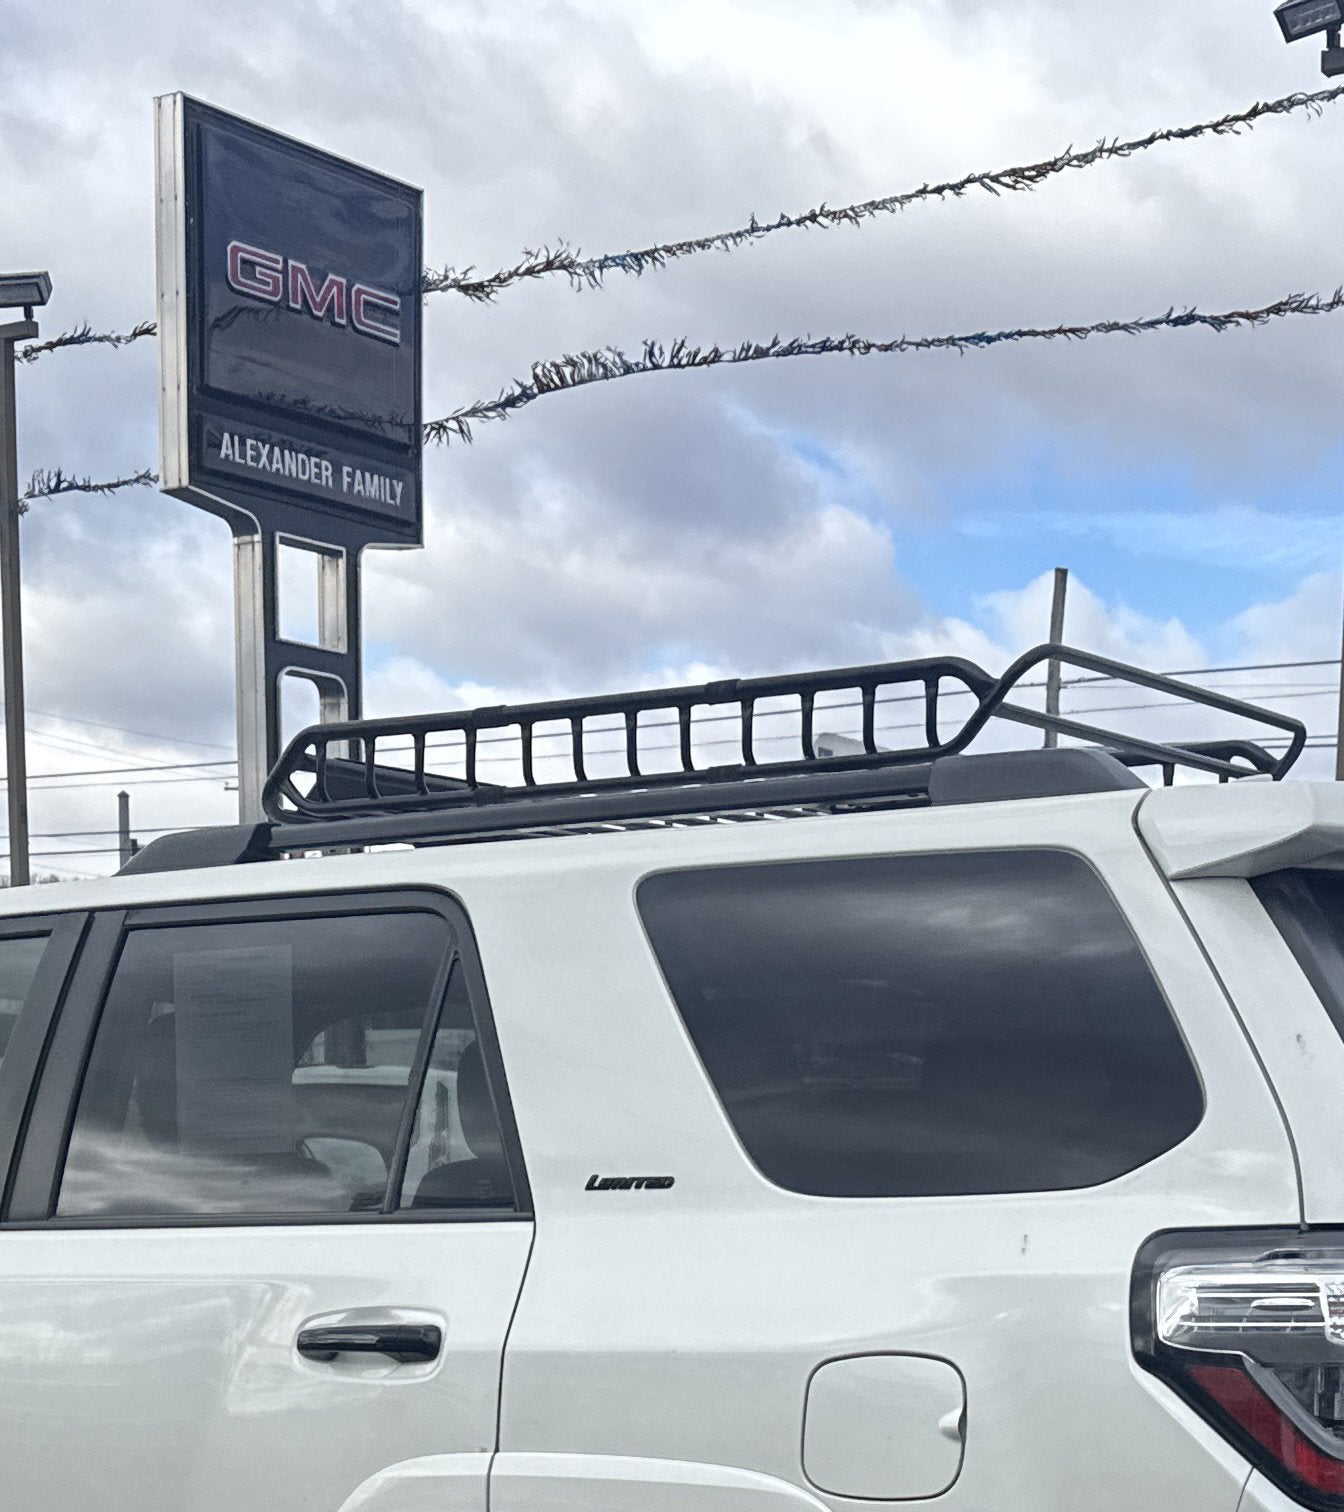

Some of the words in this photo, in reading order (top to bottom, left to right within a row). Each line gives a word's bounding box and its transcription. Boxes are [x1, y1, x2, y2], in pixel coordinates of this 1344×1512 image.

[227, 240, 401, 344] GMC
[219, 432, 333, 490] ALEXANDER
[342, 464, 404, 508] FAMILY
